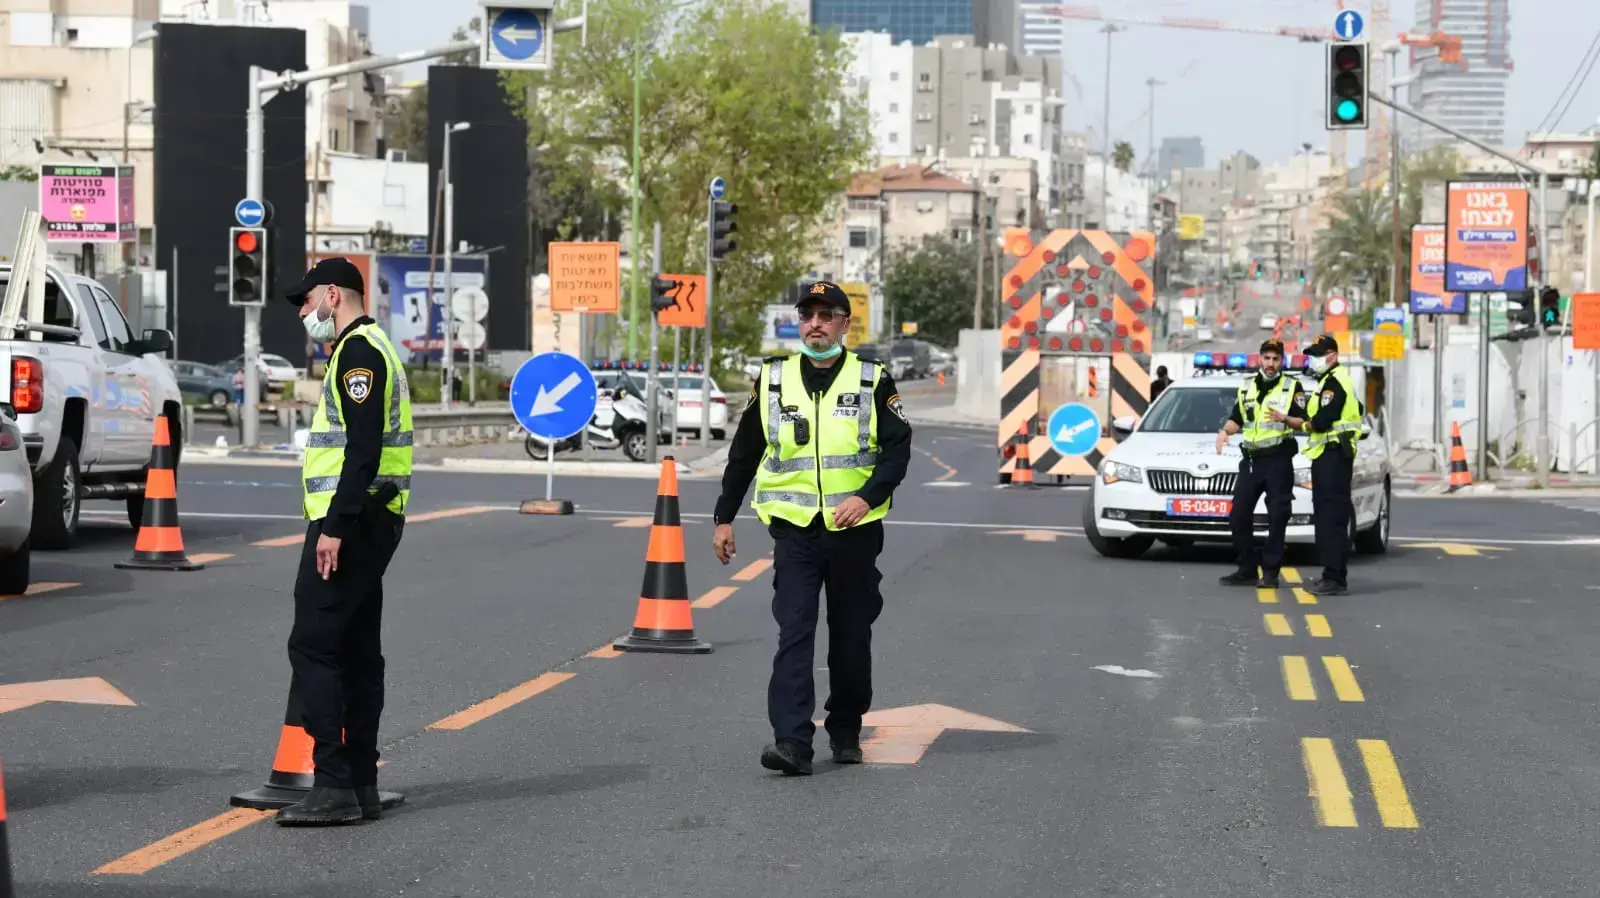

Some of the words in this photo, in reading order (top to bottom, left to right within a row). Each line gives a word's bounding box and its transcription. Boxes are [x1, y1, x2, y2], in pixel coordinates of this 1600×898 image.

[52, 179, 103, 187] סוויטות
[50, 187, 106, 196] מפוארות
[1466, 192, 1508, 208] באנו
[1461, 207, 1514, 226] לנצח!
[1424, 234, 1445, 246] אנו
[561, 252, 608, 263] משאיות
[561, 267, 607, 277] מאיטות
[556, 280, 613, 290] משתלבות
[570, 295, 598, 305] בימין
